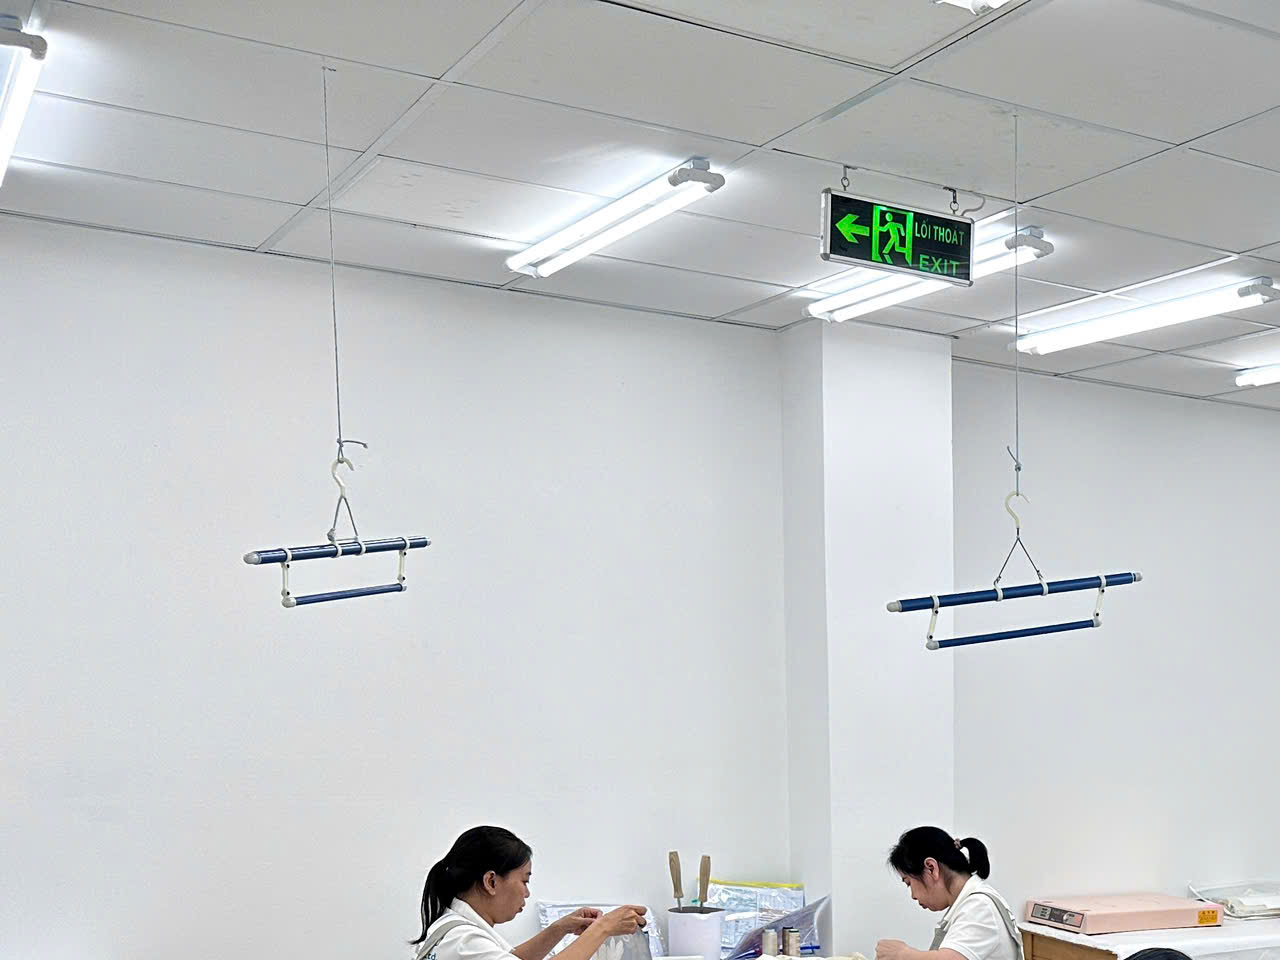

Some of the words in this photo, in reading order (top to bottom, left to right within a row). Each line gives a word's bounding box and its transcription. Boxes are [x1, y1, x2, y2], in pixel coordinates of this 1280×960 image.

[915, 218, 931, 240] LỐI
[933, 225, 964, 246] THOÁT
[919, 254, 960, 276] EXIT
